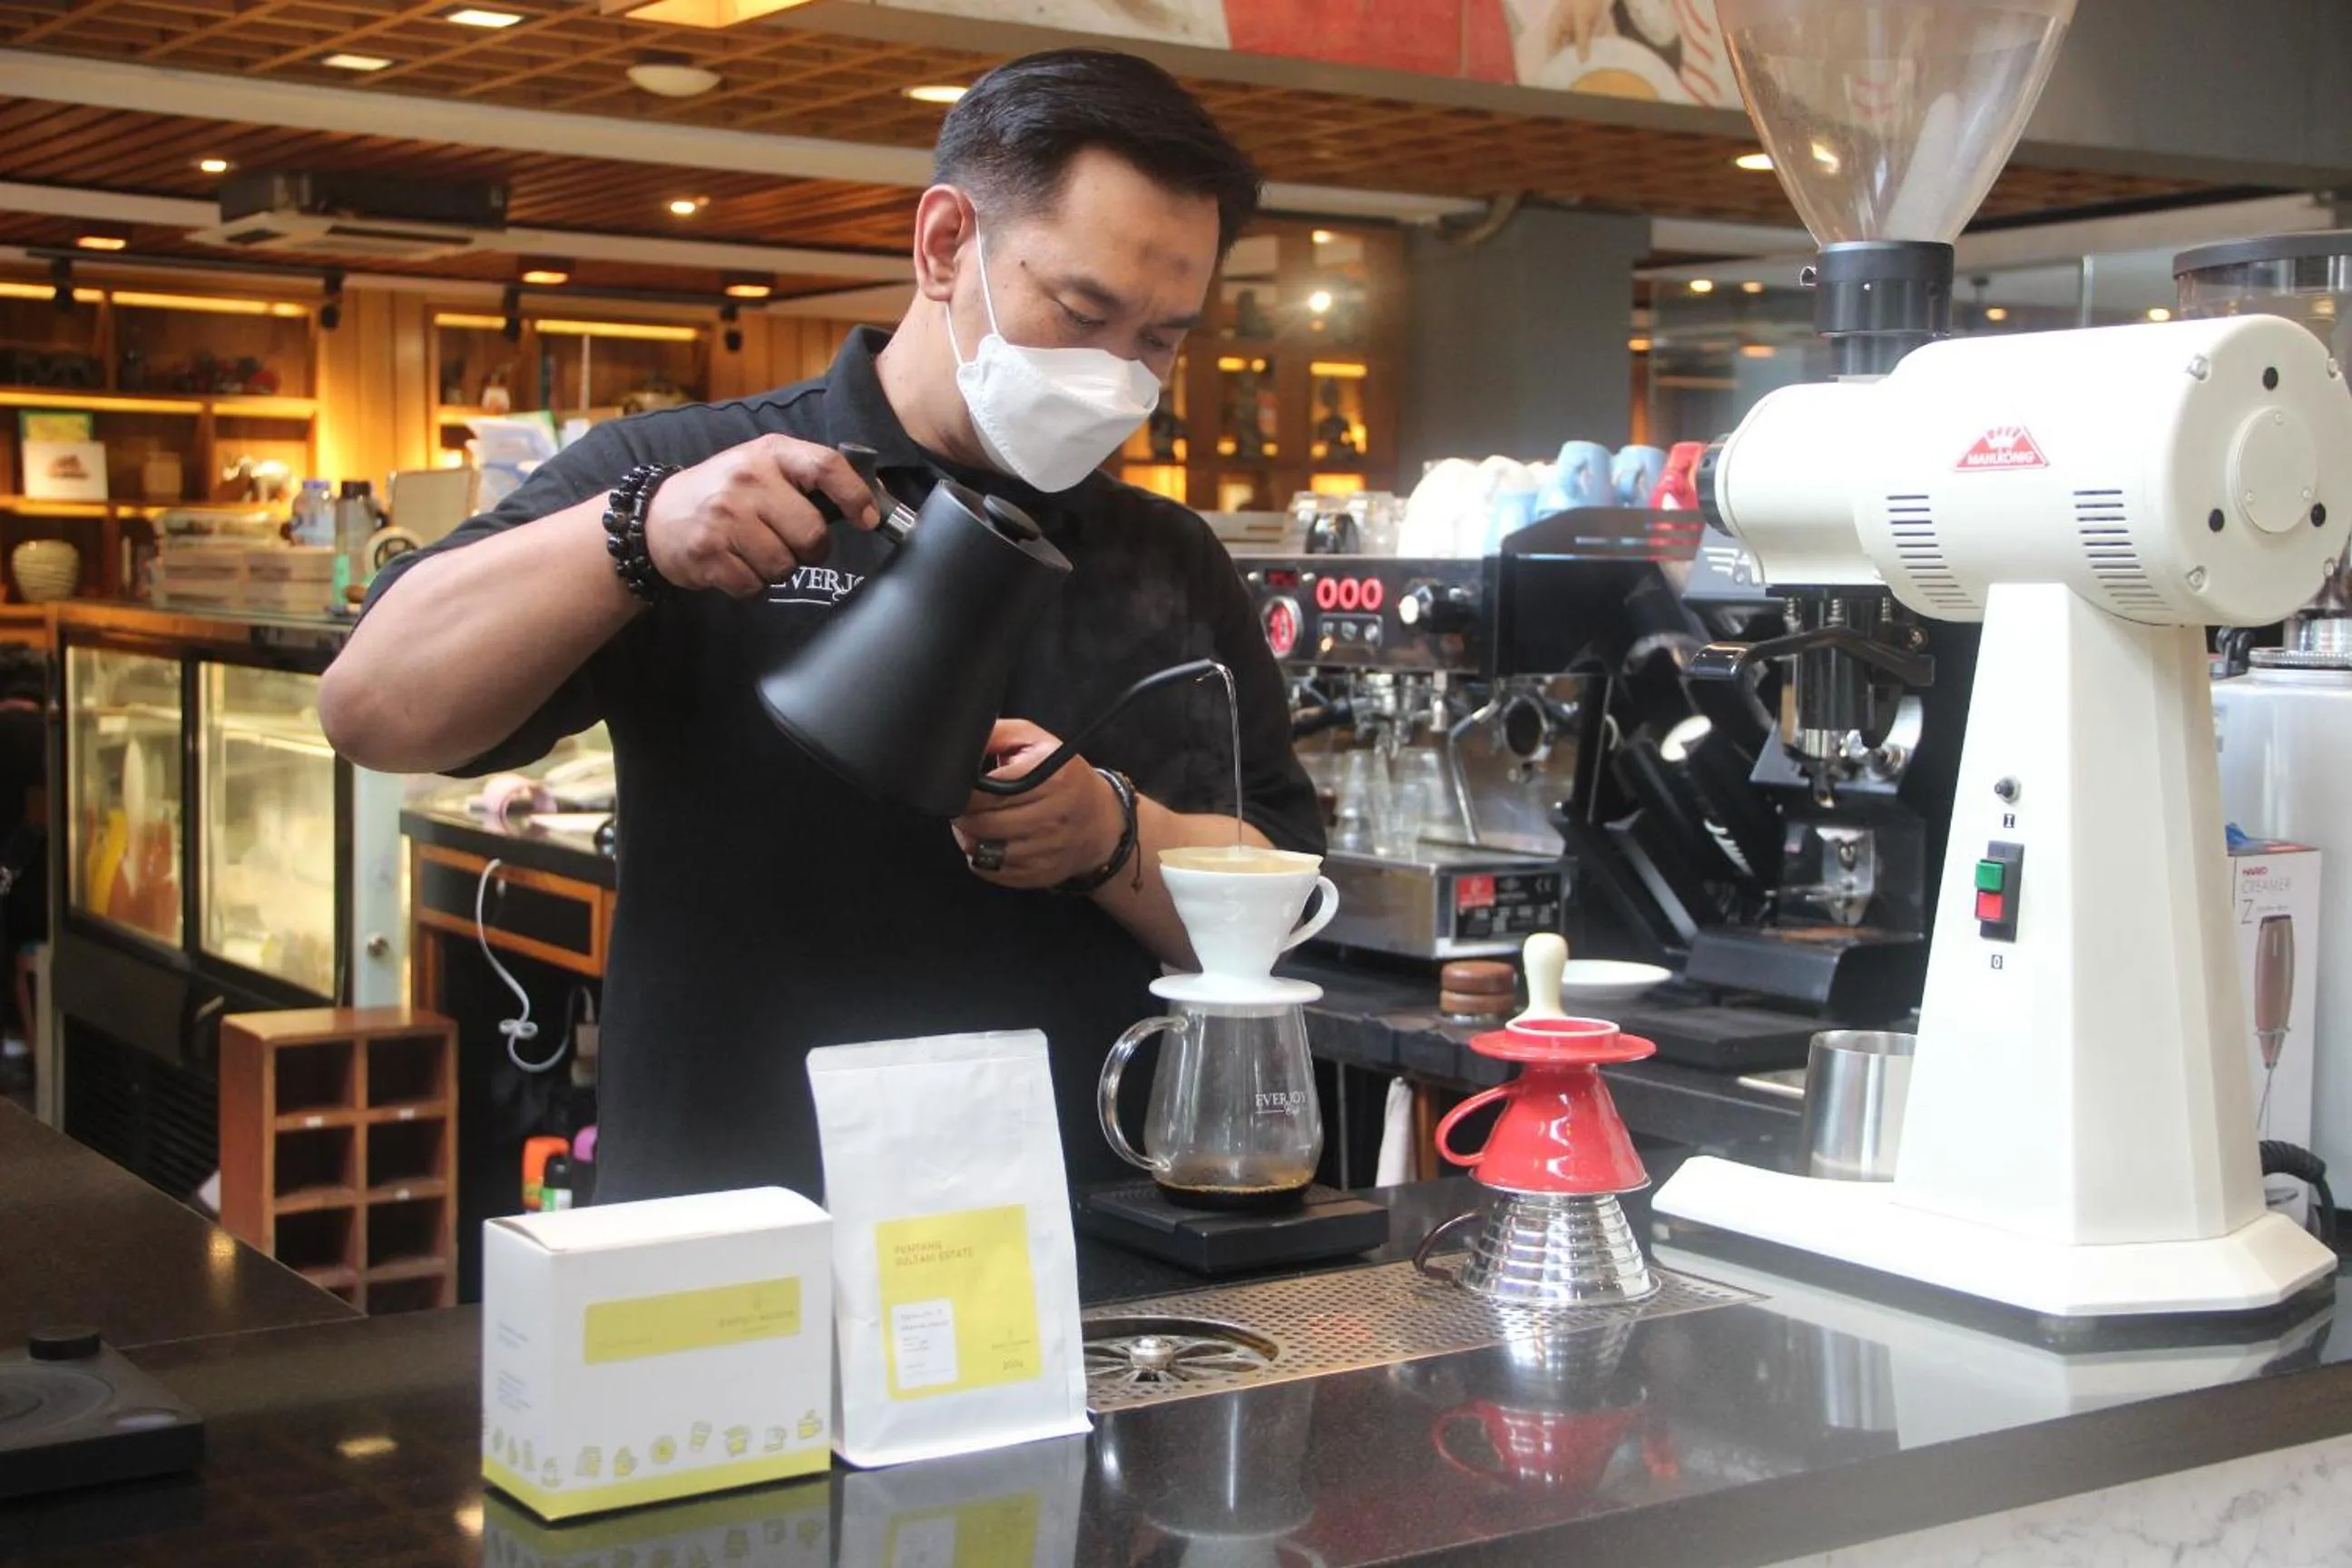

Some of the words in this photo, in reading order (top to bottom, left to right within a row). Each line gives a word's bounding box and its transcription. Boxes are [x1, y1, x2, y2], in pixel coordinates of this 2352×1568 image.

[769, 565, 866, 602] VERJ
[2240, 899, 2254, 924] Z
[1256, 1091, 1307, 1107] EVERJOY
